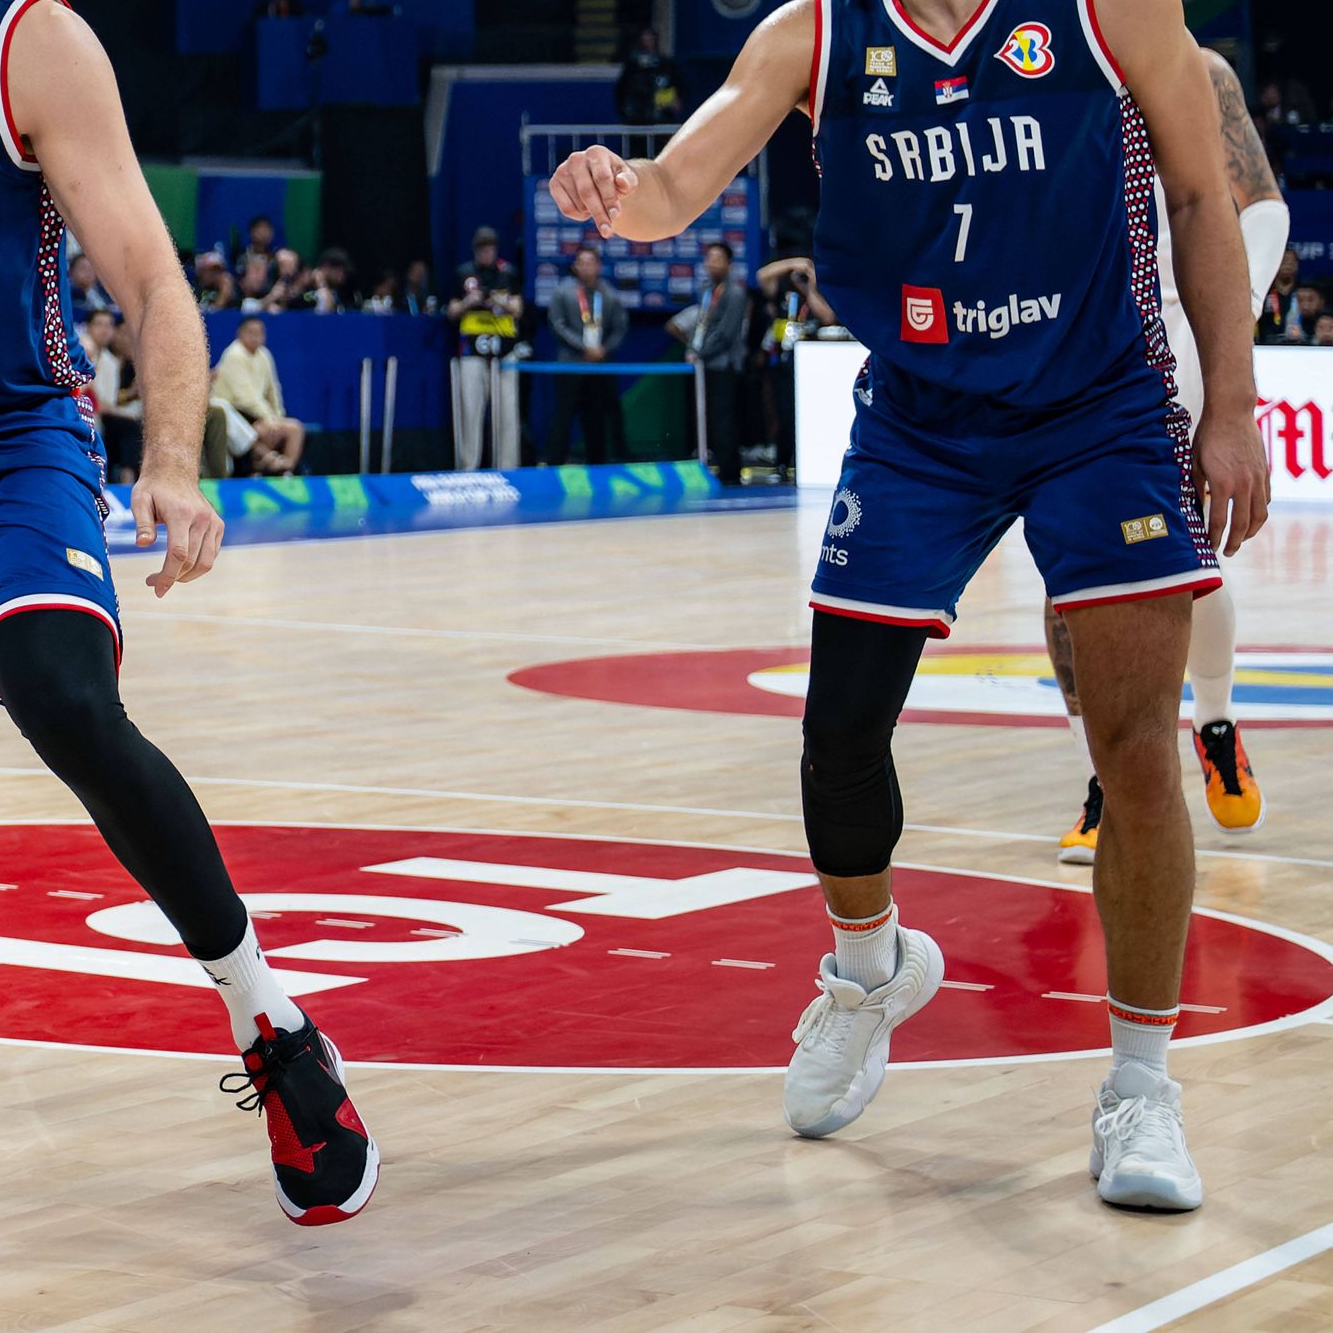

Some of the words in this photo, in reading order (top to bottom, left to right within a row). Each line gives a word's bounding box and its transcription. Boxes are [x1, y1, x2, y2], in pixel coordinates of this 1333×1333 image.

[863, 91, 895, 107] PEAK
[865, 115, 1046, 182] SRBIJA
[953, 203, 973, 262] 7
[952, 293, 1062, 340] triglav
